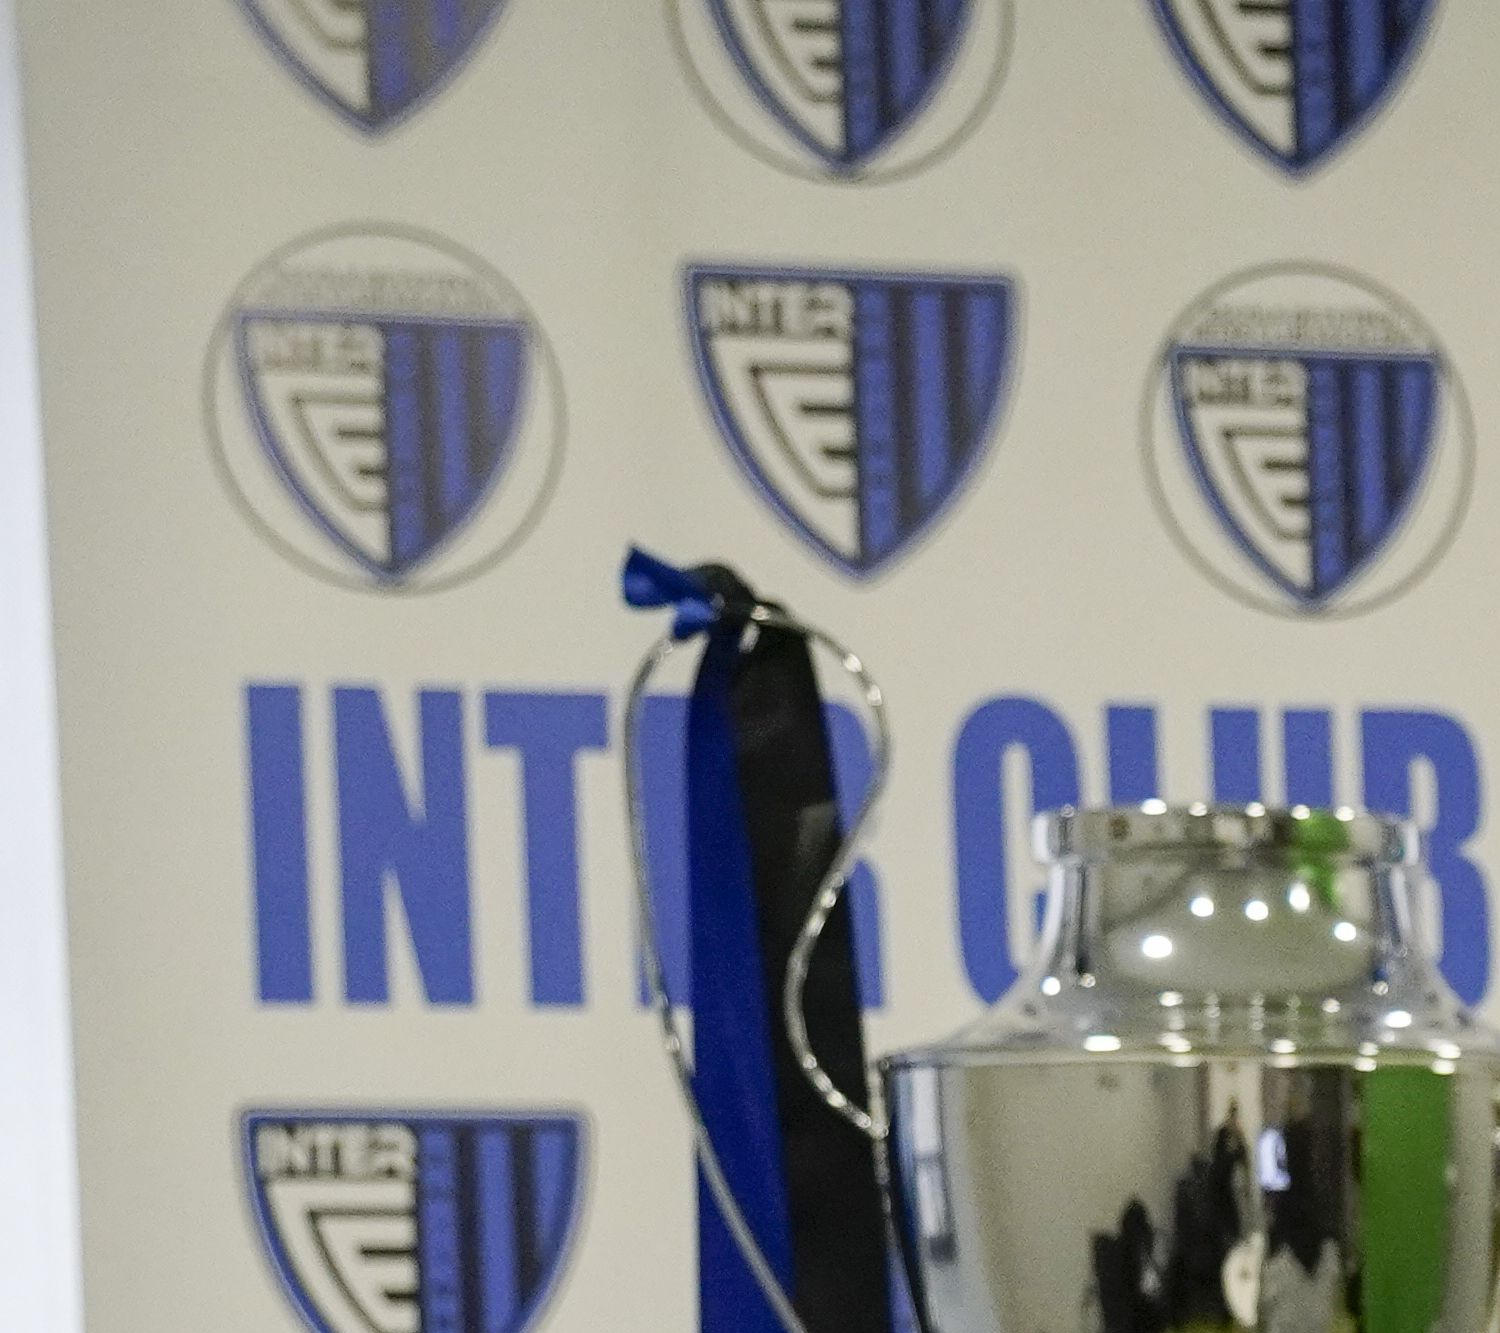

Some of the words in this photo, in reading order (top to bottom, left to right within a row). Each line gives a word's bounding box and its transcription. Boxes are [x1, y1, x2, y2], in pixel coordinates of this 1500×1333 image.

[697, 280, 855, 338] INTER
[1182, 357, 1309, 406] INTER
[255, 1123, 418, 1180] INTER
